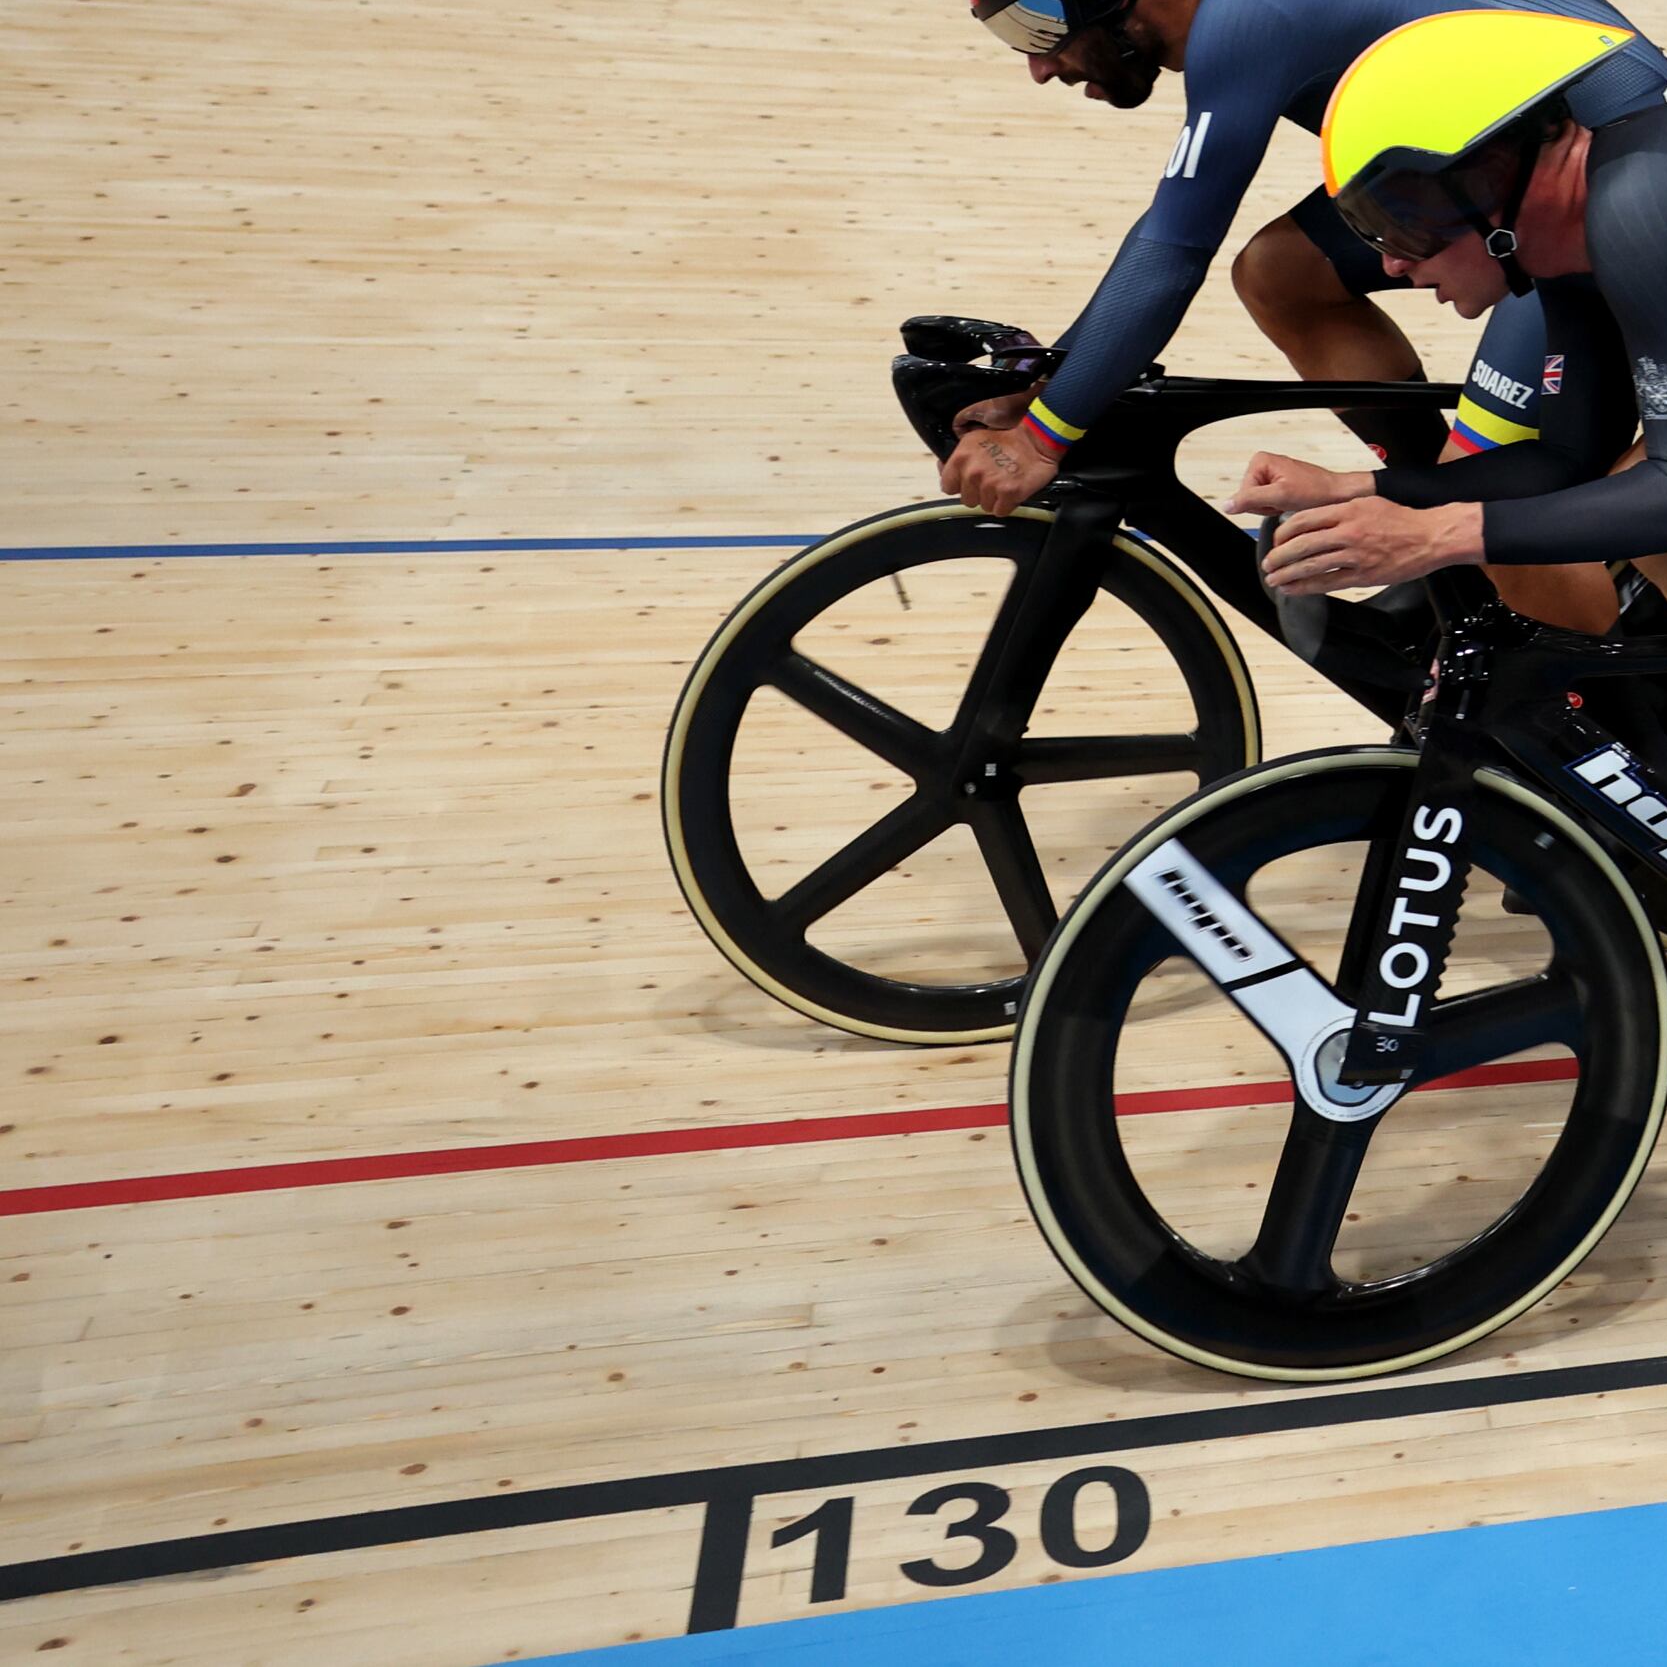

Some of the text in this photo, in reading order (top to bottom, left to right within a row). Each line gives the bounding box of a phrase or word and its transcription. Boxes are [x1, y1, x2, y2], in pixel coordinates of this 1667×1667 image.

[1471, 358, 1535, 411] SUAREZ
[1366, 803, 1463, 1030] LOTUS
[1375, 1035, 1400, 1053] 30
[770, 1464, 1151, 1605] 130
